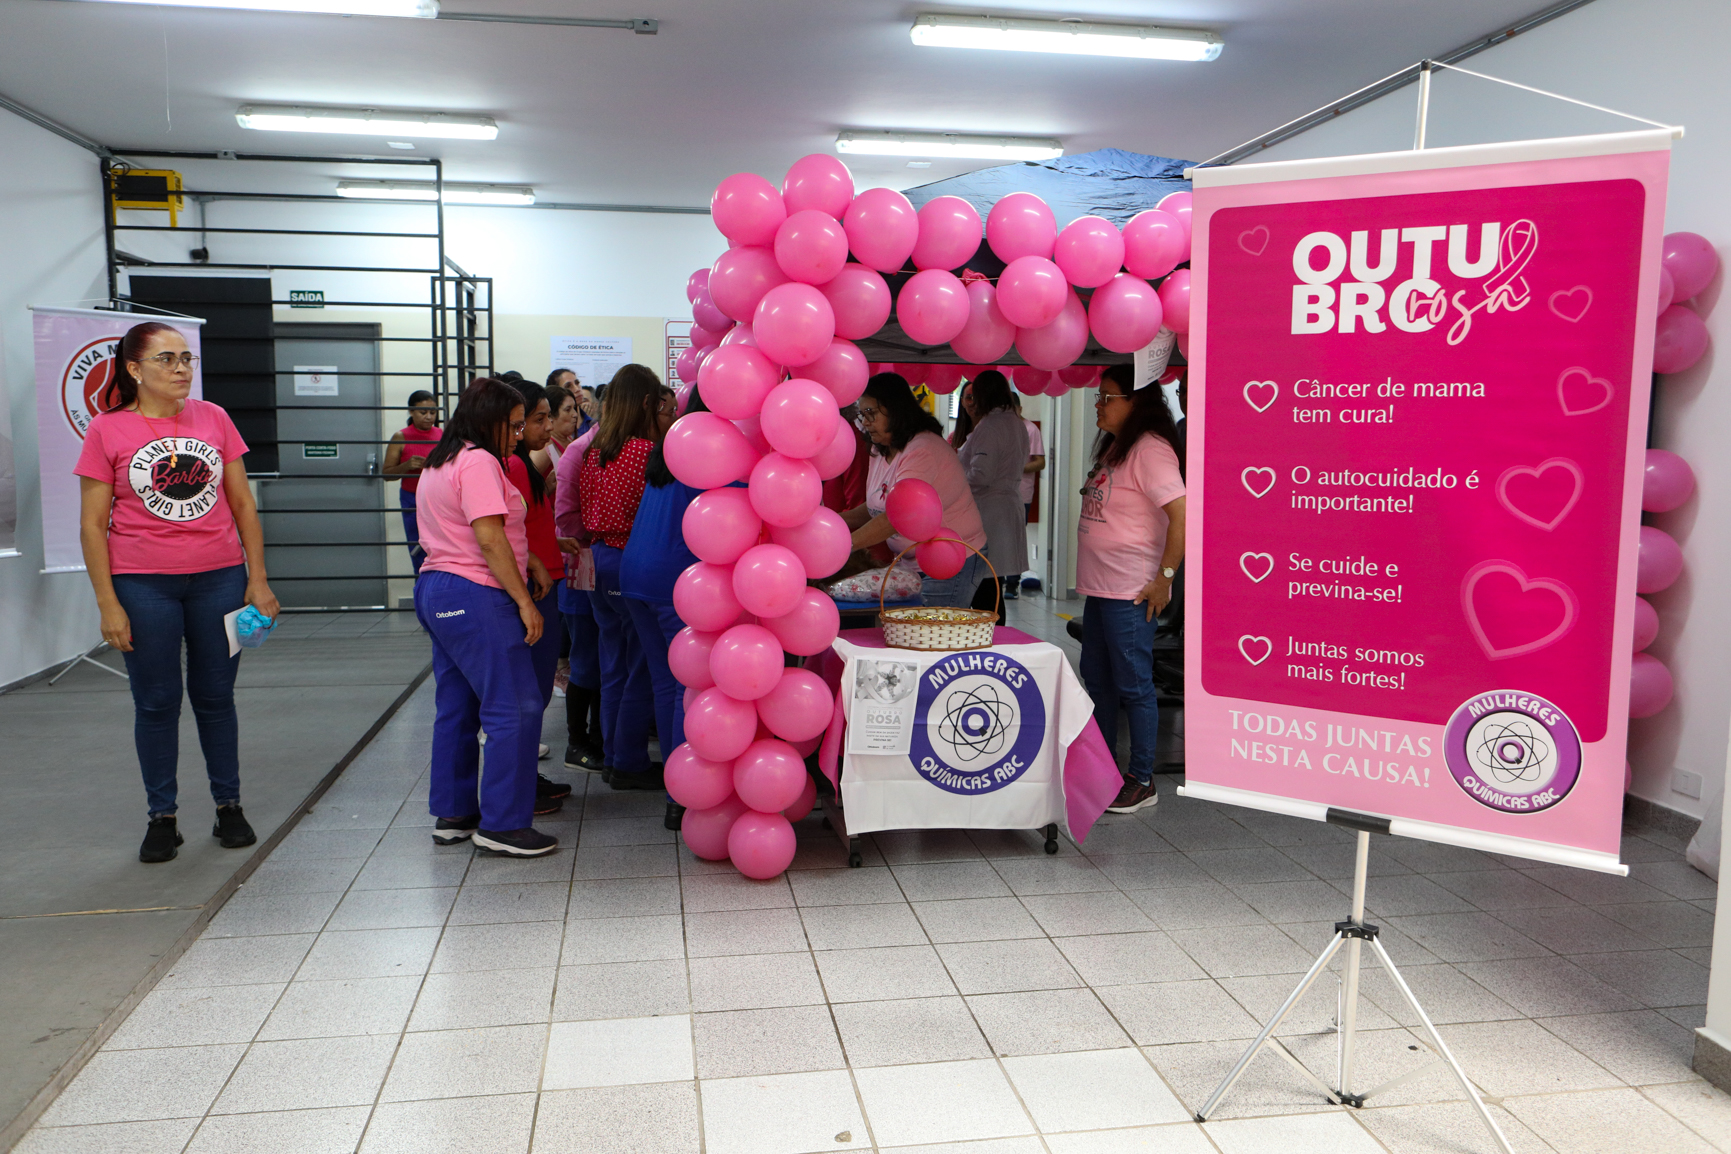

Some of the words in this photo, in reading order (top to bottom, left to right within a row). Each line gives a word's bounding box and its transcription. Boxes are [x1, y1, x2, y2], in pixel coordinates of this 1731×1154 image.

[1292, 222, 1501, 285] OUTU
[291, 291, 323, 302] SAÍDA
[1291, 278, 1442, 335] BRO
[72, 350, 104, 381] VIVA
[1293, 379, 1370, 398] Câncer
[1377, 377, 1405, 397] de
[1413, 382, 1485, 397] mama
[1293, 406, 1331, 423] tem
[1339, 404, 1394, 423] cura!
[133, 440, 178, 471] PLANET
[185, 440, 220, 466] GIRLS
[150, 460, 217, 491] Barbie
[1291, 465, 1311, 485] O
[1317, 467, 1457, 489] autocuidado
[1465, 470, 1479, 489] é
[138, 485, 174, 516] GIRLS
[178, 484, 216, 517] PLANET
[1291, 490, 1414, 514] importante!
[1288, 552, 1312, 571] Se
[1319, 556, 1378, 576] cuide
[1385, 563, 1399, 577] e
[1288, 580, 1402, 603] previna-se!
[435, 609, 466, 619] Ortobom
[1286, 636, 1348, 659] Juntas
[1355, 648, 1425, 667] somos
[928, 654, 1028, 689] MULHERES
[1287, 663, 1333, 682] mais
[1341, 665, 1406, 690] fortes!
[866, 713, 901, 725] ROSA
[1467, 694, 1562, 726] MULHERES
[1228, 709, 1317, 742] TODAS
[1325, 724, 1432, 758] JUNTAS
[920, 756, 991, 790] QUÍMICAS
[993, 755, 1025, 784] ABC
[1230, 738, 1313, 770] NESTA
[1322, 753, 1430, 788] CAUSA!
[1463, 776, 1530, 809] QUÍMICAS
[1531, 787, 1560, 808] ABC
